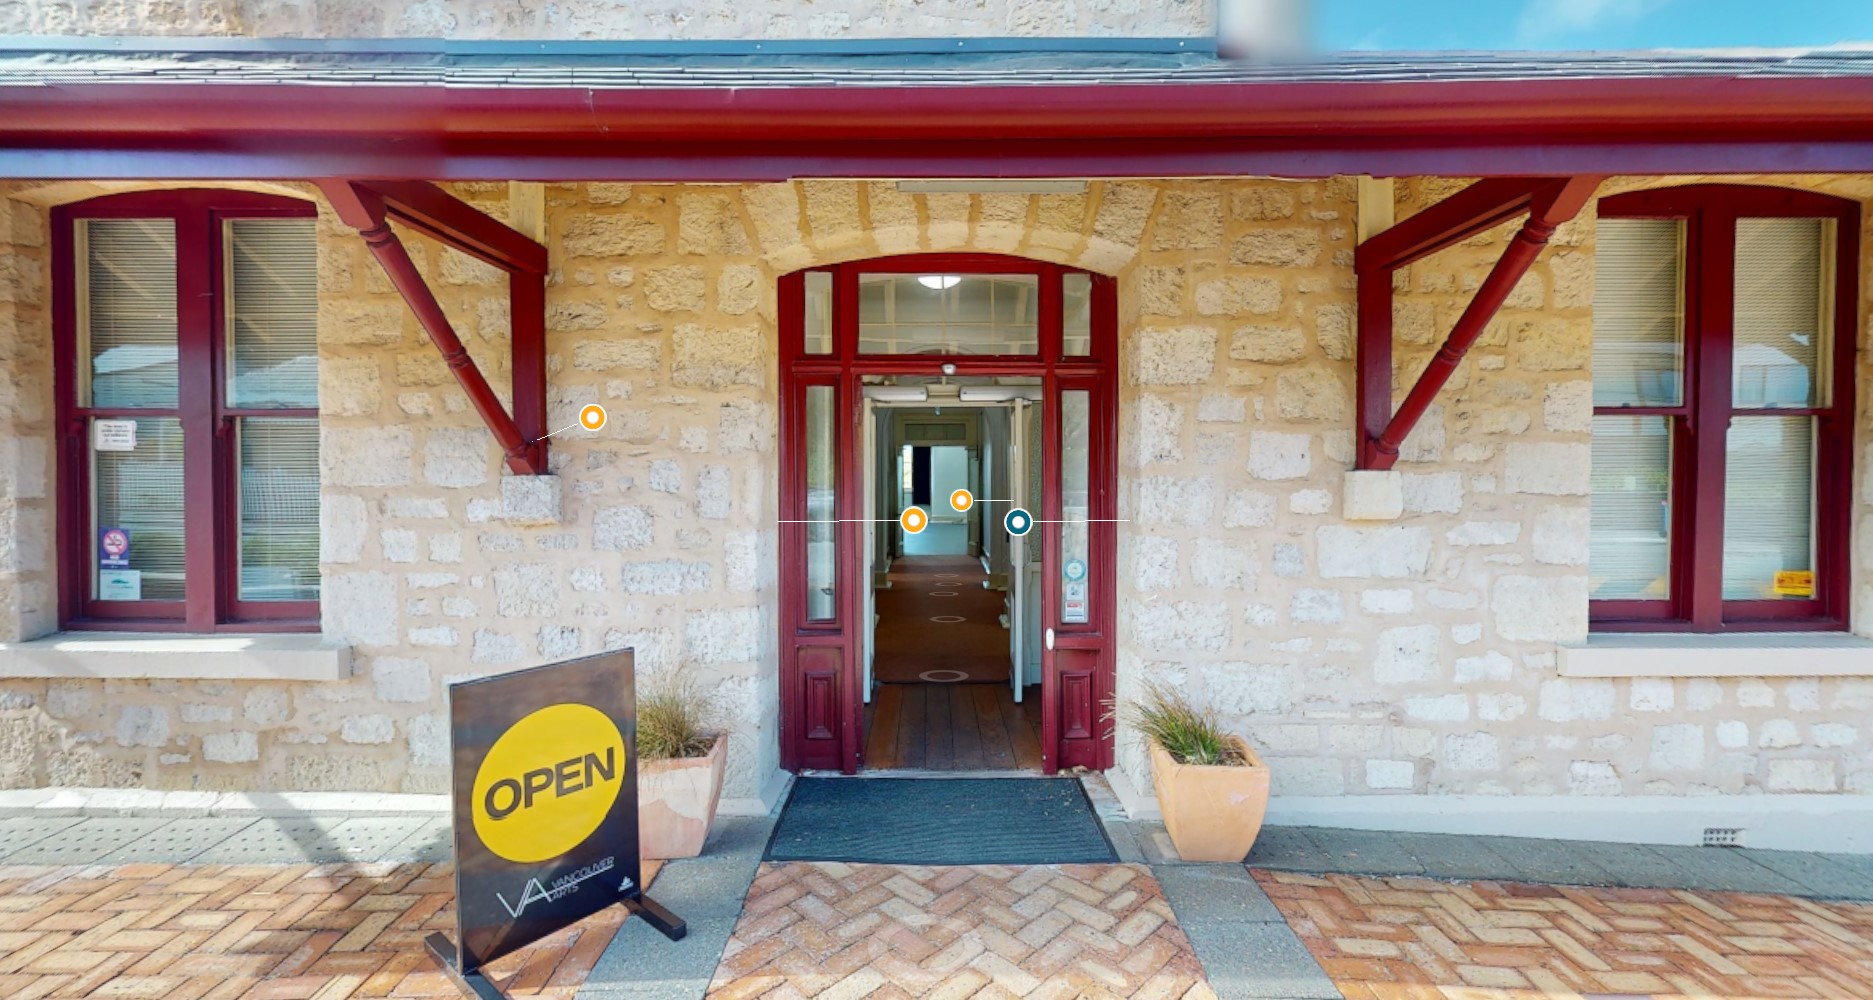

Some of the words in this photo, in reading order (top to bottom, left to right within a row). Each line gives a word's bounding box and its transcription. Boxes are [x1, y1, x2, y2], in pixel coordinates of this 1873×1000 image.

[484, 747, 615, 819] OPEN
[551, 856, 615, 889] VANCOUVER
[551, 884, 580, 901] ARTS
